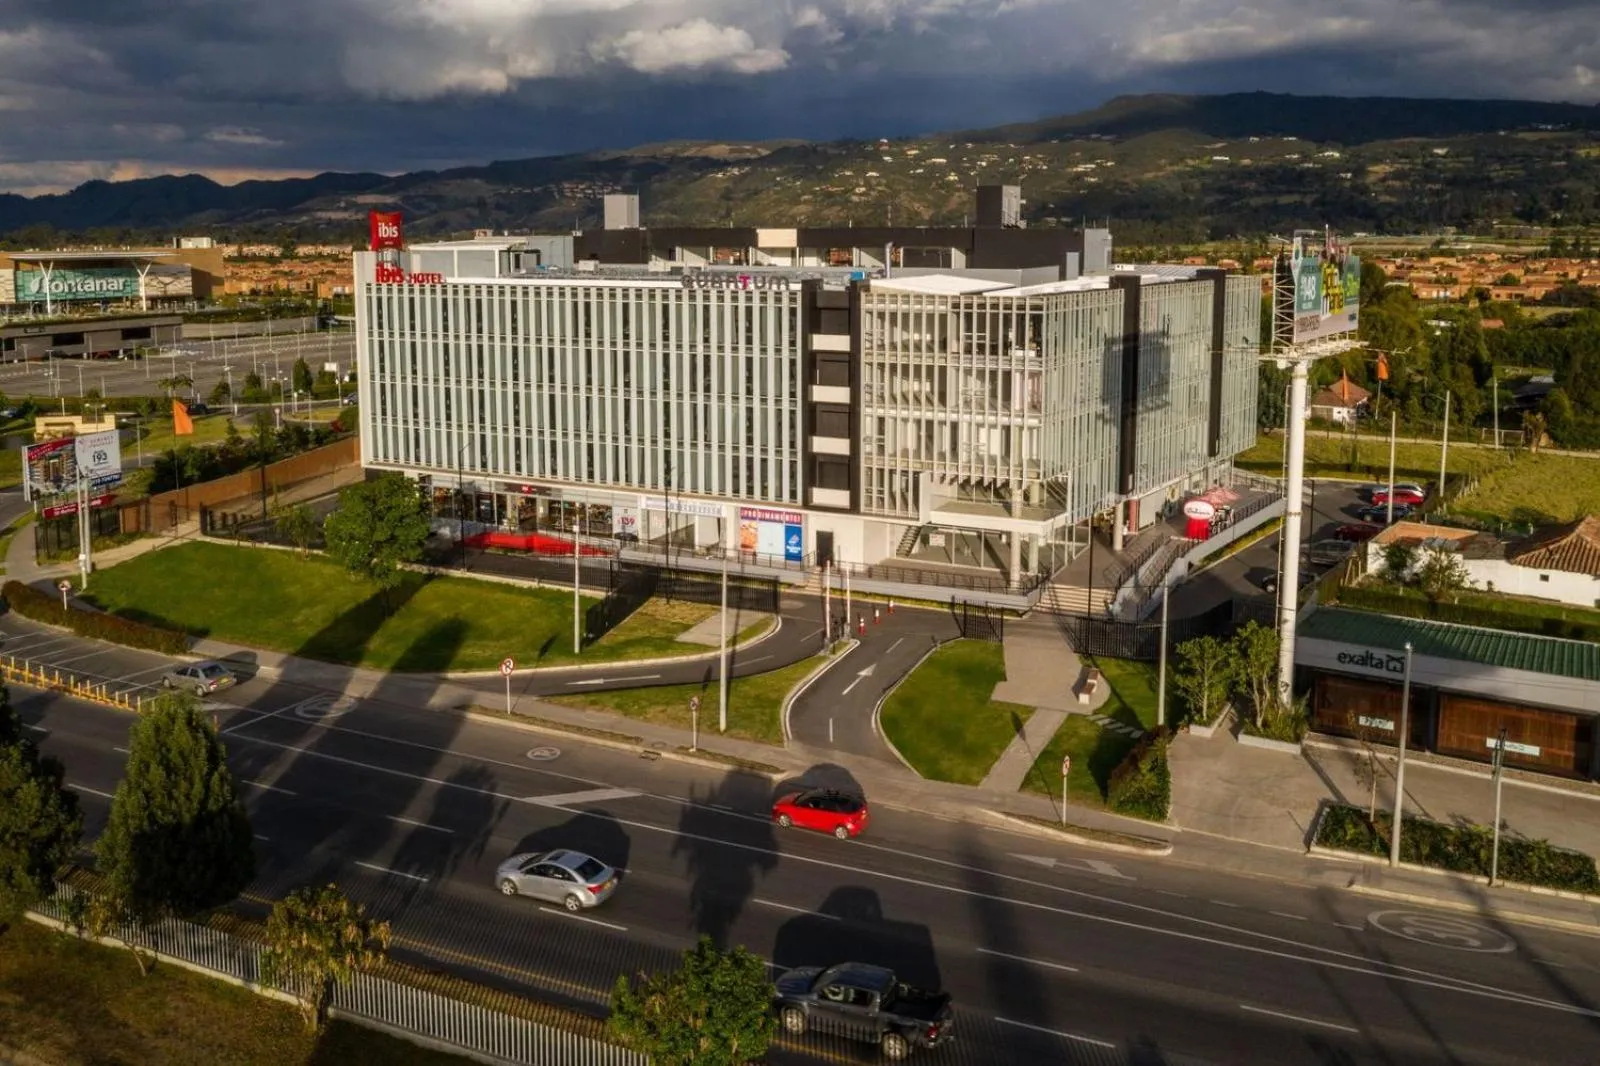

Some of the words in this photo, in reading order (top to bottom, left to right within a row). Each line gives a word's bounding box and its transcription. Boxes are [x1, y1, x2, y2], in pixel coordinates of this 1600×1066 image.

[378, 222, 399, 238] ibis
[376, 261, 404, 284] ibis
[409, 272, 443, 284] HOTEL
[1336, 650, 1384, 670] exalta
